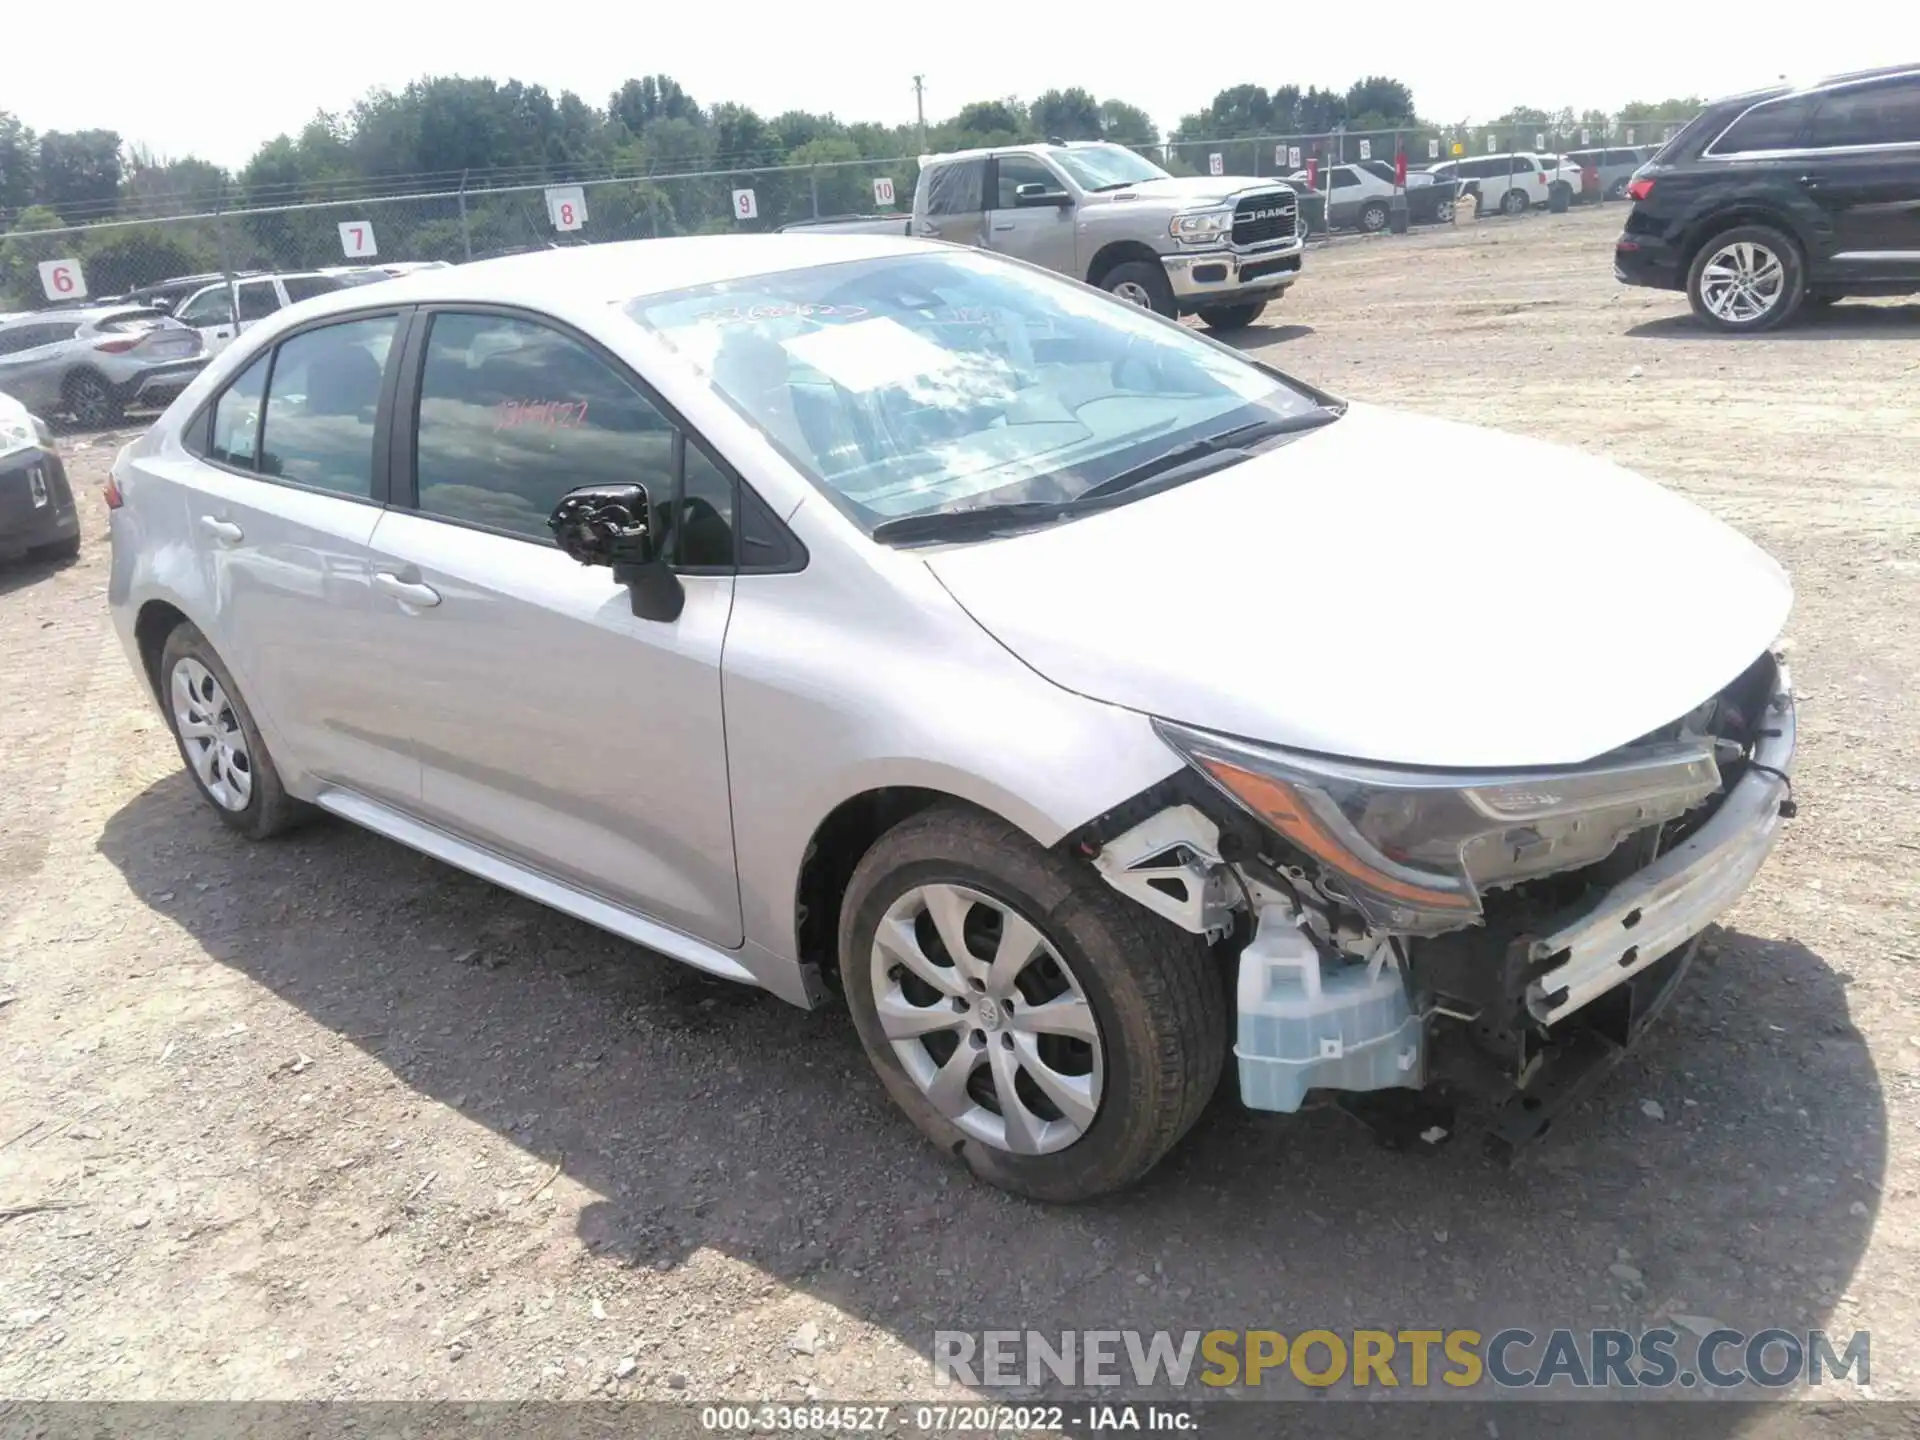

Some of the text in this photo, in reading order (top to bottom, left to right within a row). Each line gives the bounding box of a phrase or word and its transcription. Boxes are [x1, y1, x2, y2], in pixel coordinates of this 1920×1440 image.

[876, 183, 892, 199] 10
[739, 194, 750, 213] 9
[1256, 206, 1285, 220] RAM
[560, 204, 574, 225] 8
[348, 228, 363, 250] 7
[53, 267, 74, 292] 6
